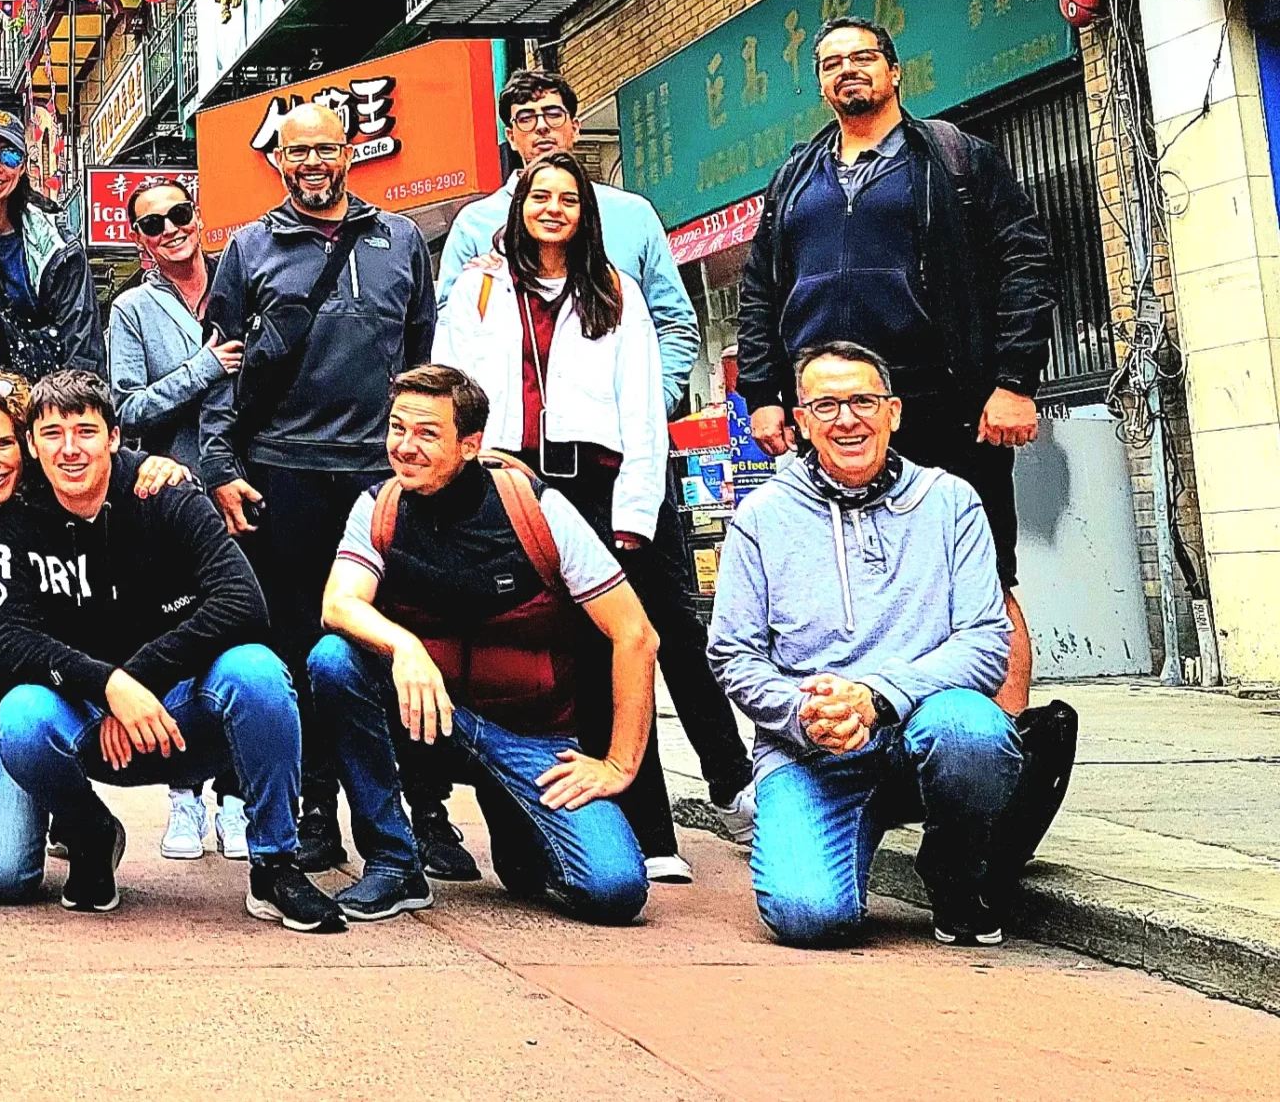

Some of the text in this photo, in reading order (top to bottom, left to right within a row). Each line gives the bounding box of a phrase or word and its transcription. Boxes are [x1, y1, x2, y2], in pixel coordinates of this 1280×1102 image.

[362, 142, 389, 157] Cafe
[385, 171, 466, 201] 415-956-2902
[702, 209, 729, 237] EBT
[206, 229, 223, 244] 139
